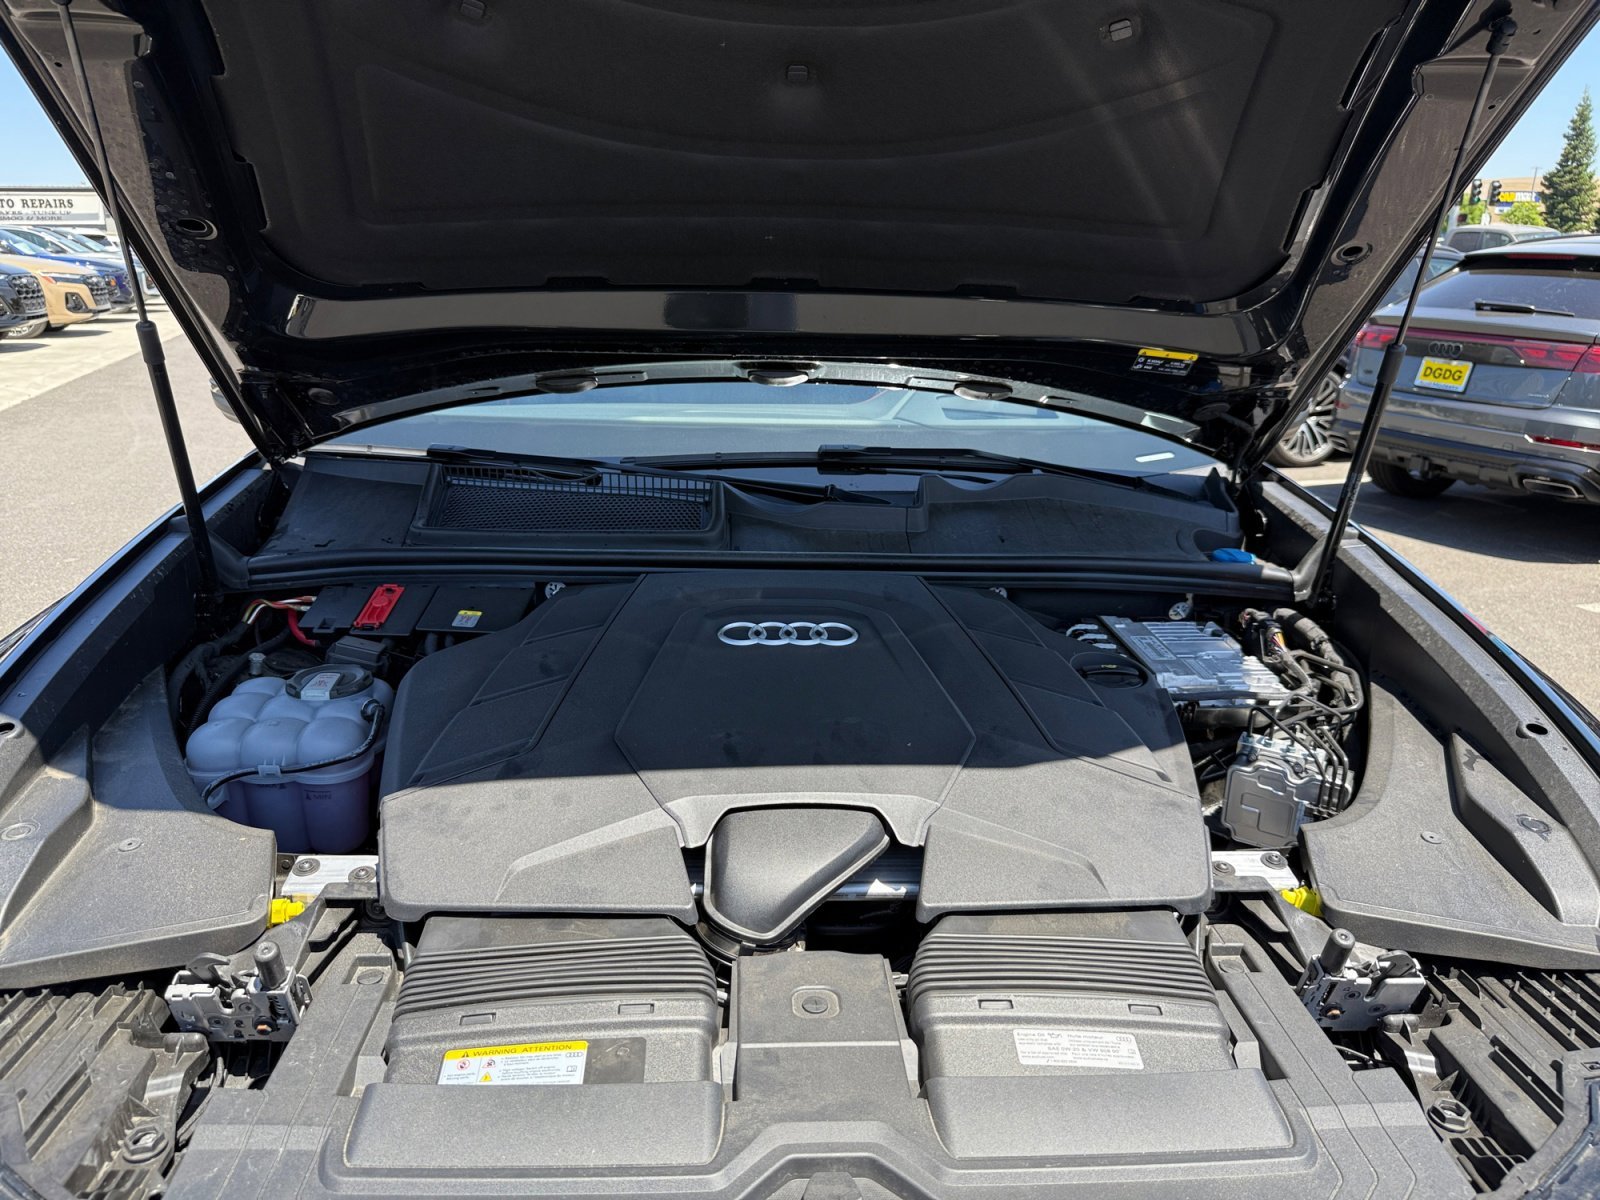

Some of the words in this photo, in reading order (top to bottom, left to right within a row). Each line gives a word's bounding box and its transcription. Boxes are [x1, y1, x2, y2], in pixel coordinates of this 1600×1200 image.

[20, 198, 74, 209] REPAIRS
[1423, 366, 1463, 381] DGDG
[473, 1048, 517, 1057] WARNING
[522, 1044, 572, 1054] ATTENTION
